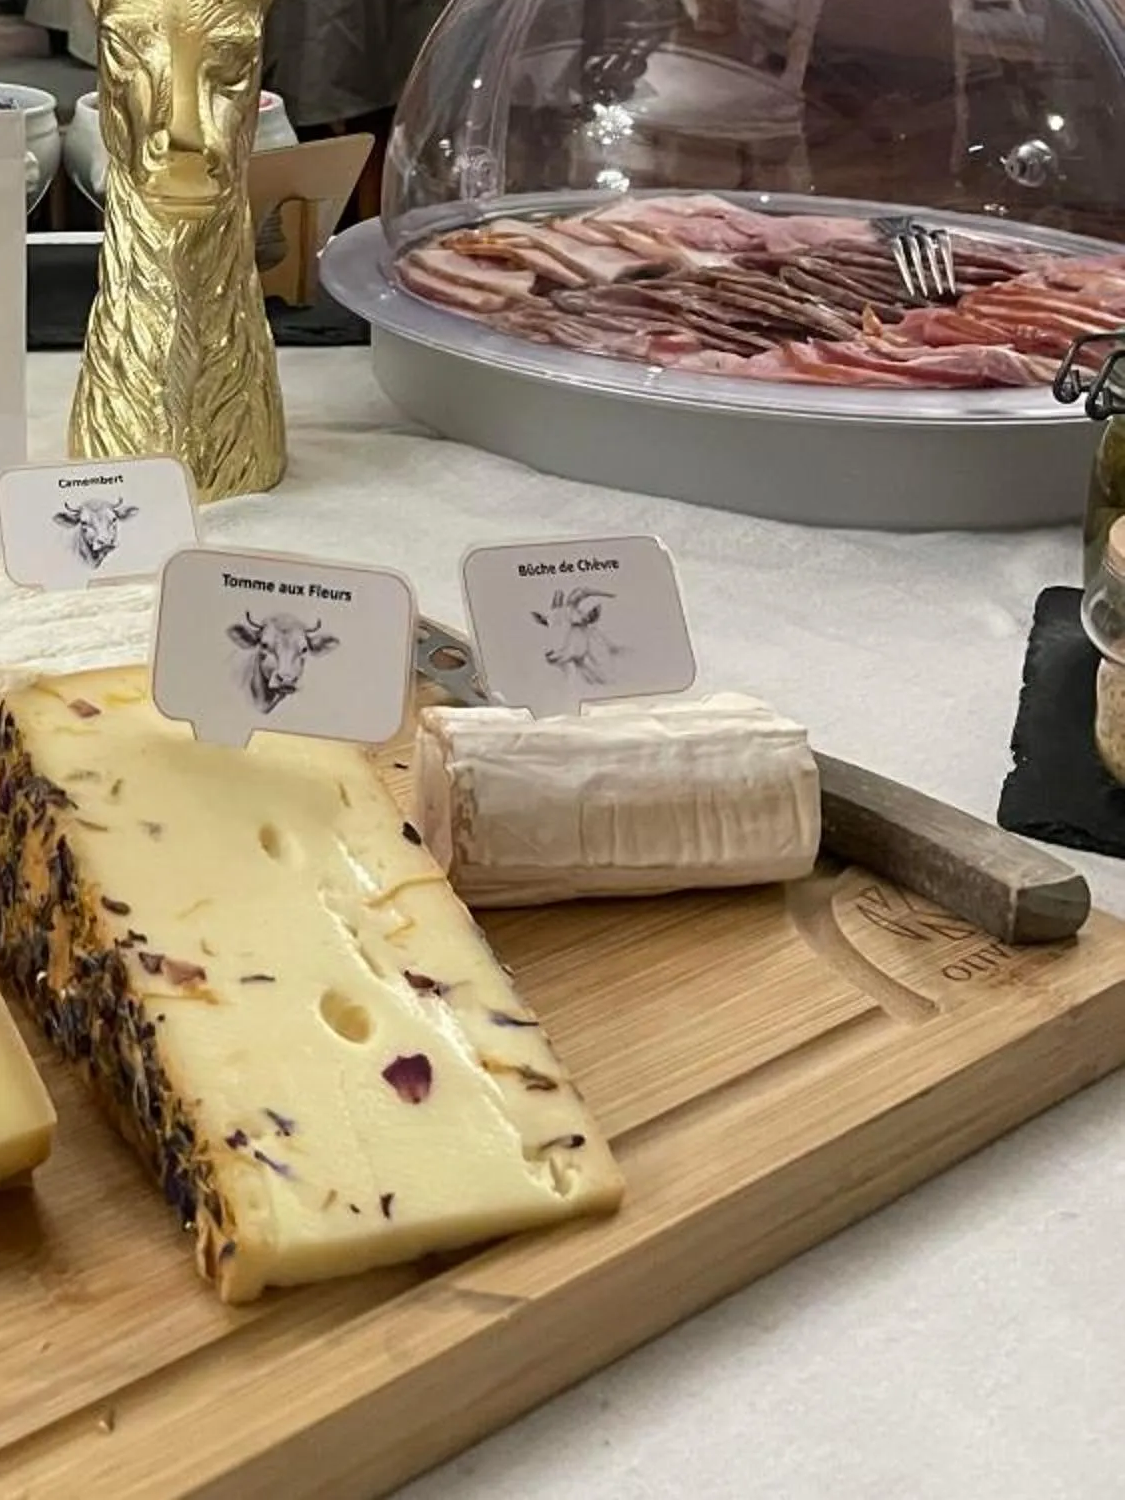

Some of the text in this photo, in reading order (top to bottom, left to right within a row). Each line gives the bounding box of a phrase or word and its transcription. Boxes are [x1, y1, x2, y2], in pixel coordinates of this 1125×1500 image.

[58, 475, 124, 489] Camembert
[518, 557, 619, 577] Bûche de Chèvre
[222, 572, 352, 602] Tomme aux Fleurs
